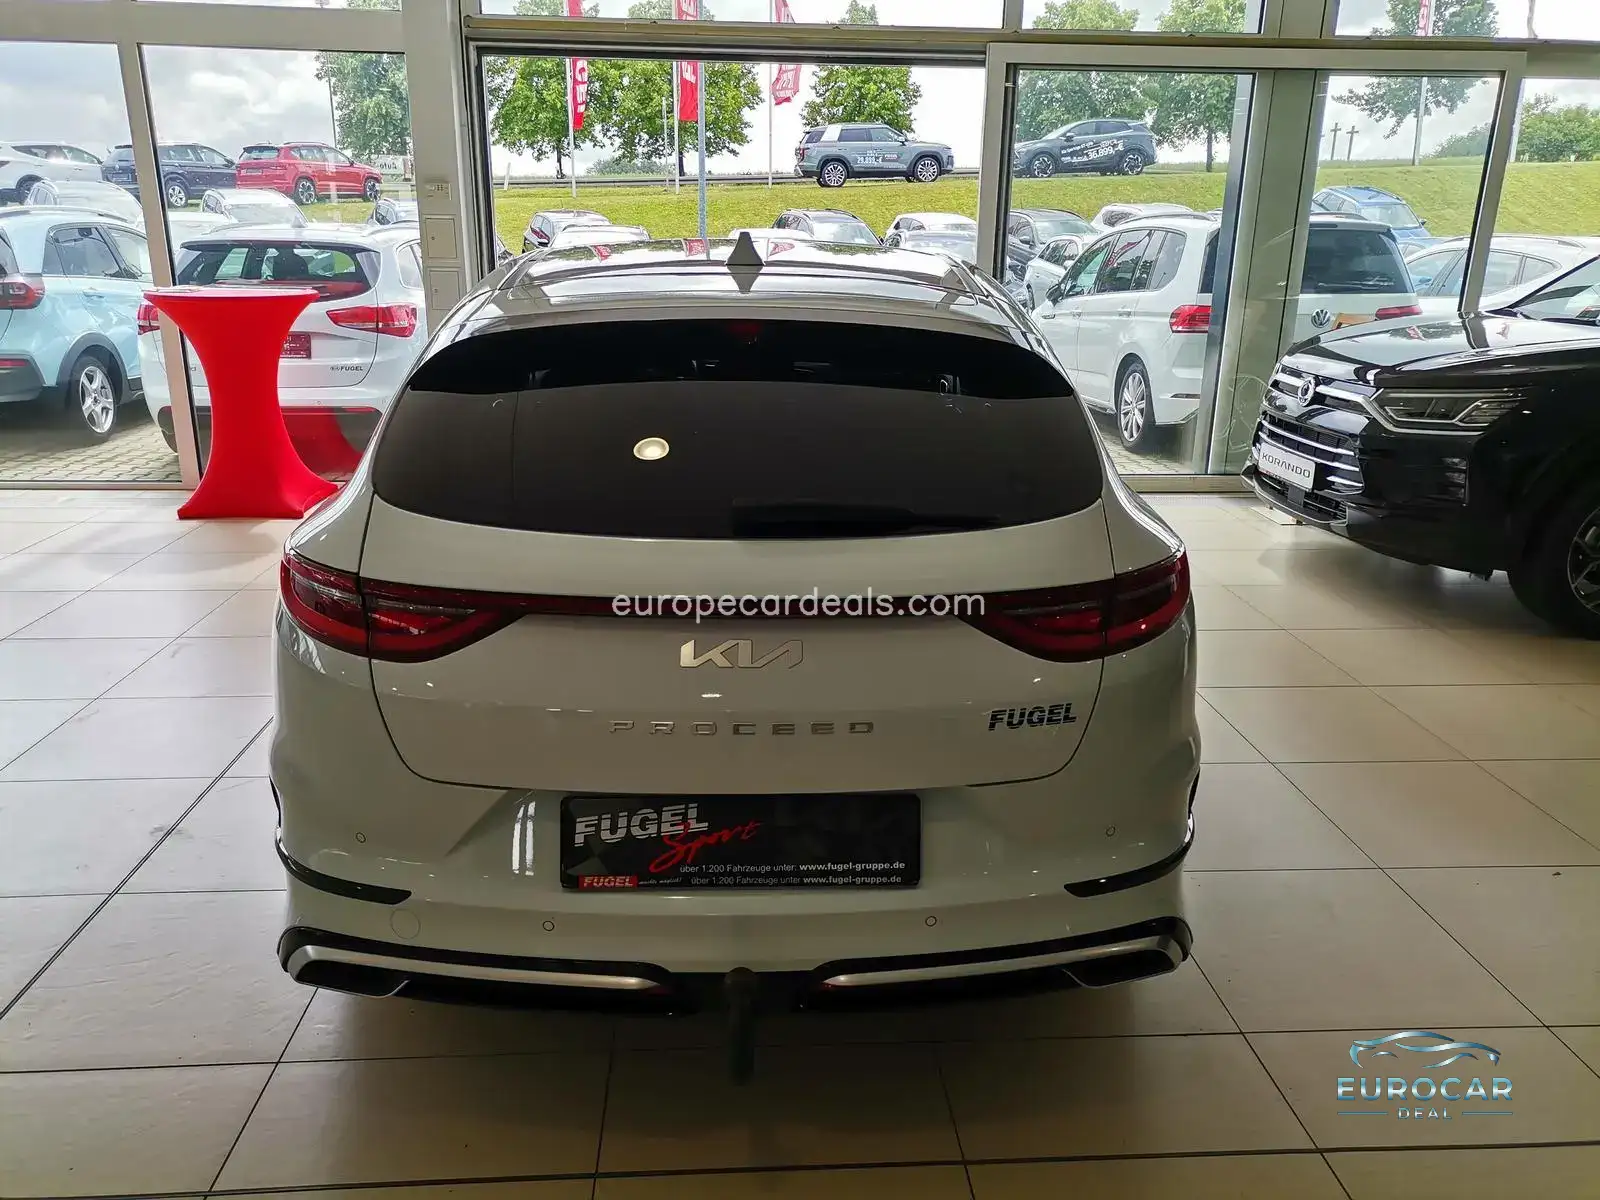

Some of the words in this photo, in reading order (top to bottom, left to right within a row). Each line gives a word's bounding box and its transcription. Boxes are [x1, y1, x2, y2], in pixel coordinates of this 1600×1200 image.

[1261, 452, 1311, 479] KORANDO
[609, 720, 875, 736] PROCEED
[988, 703, 1077, 732] FUGEL
[574, 803, 708, 847] FUGEL
[649, 820, 764, 874] Sport
[680, 864, 699, 873] über
[702, 863, 724, 873] 1.200
[727, 863, 771, 874] Fahrzeuge
[799, 861, 905, 873] www.fugel-gruppe.de
[583, 876, 634, 888] FUGEL
[691, 876, 708, 885] über
[712, 876, 734, 885] 1.200
[736, 876, 780, 886] Fahrzeuge
[803, 875, 903, 886] www.fugel-gruppe.de
